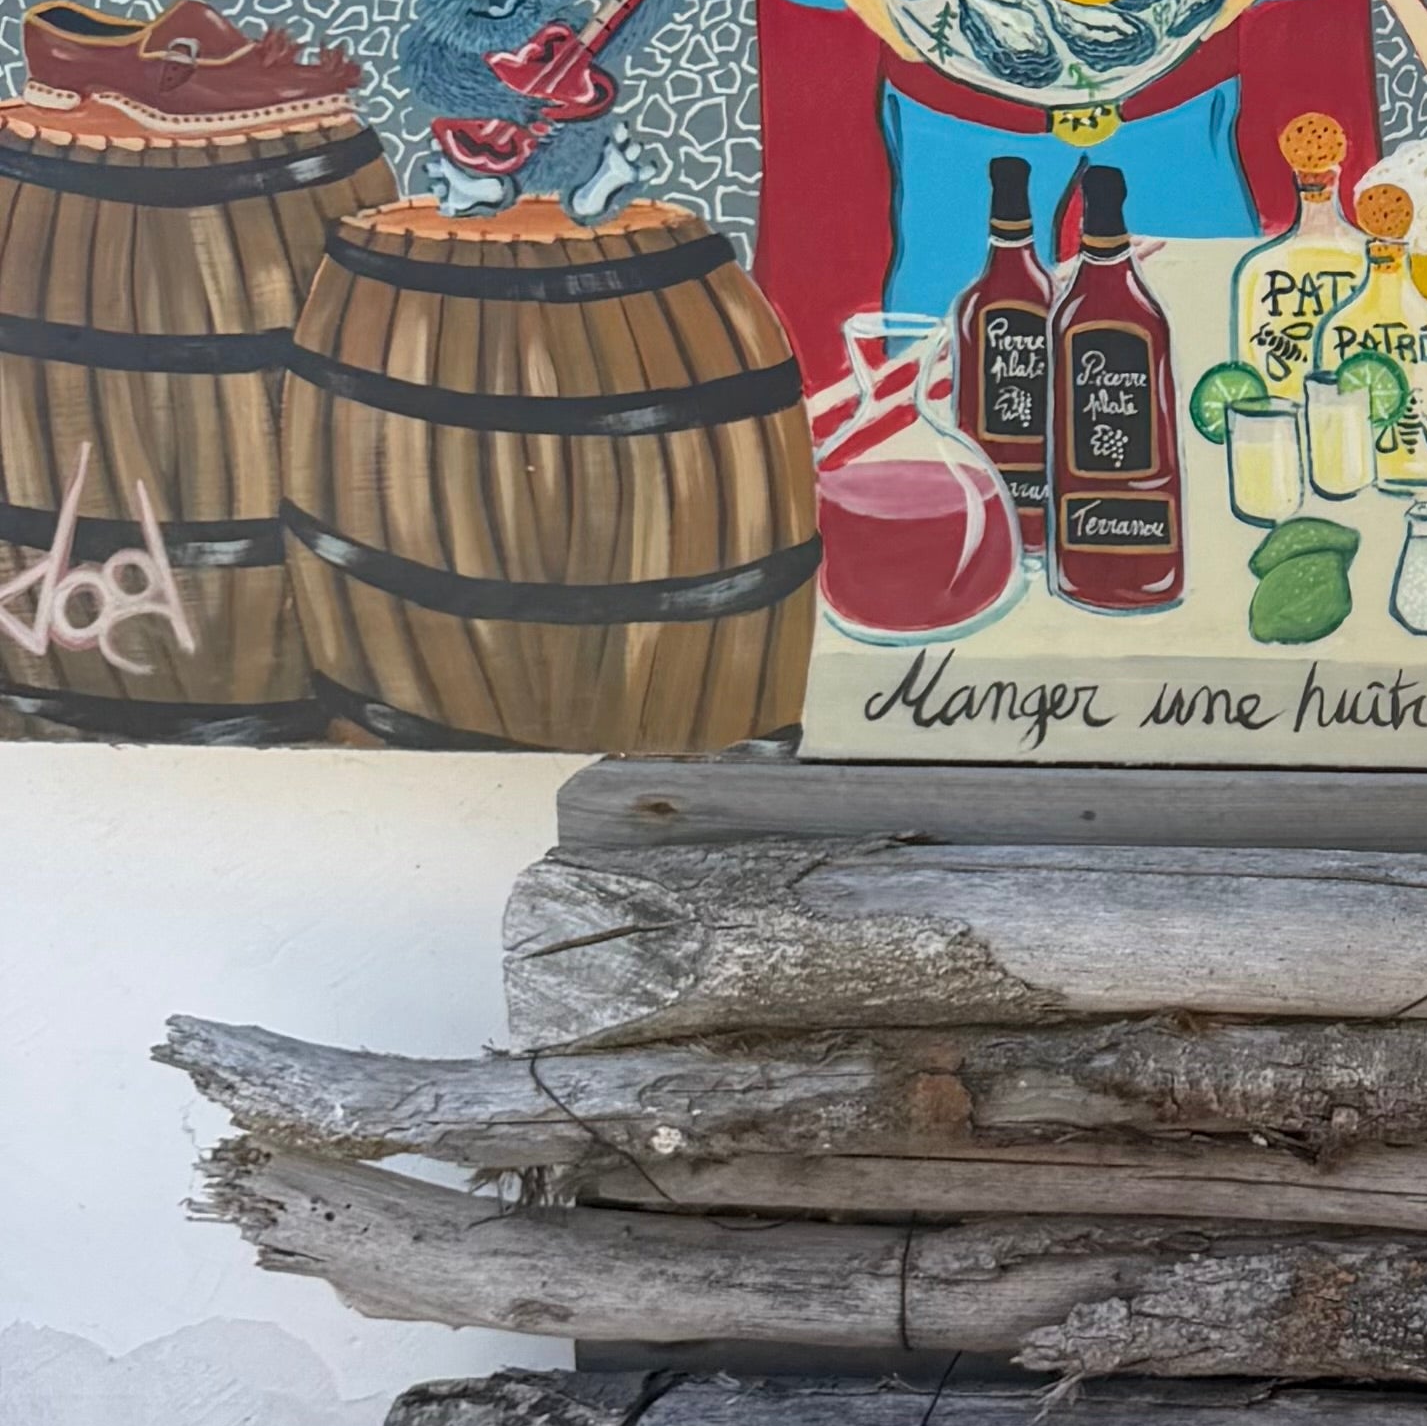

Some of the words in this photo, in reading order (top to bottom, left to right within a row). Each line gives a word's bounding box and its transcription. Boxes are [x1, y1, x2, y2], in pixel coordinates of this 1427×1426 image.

[1260, 269, 1358, 317] PAT
[863, 647, 1120, 755] Manger
[1138, 682, 1290, 731] une
